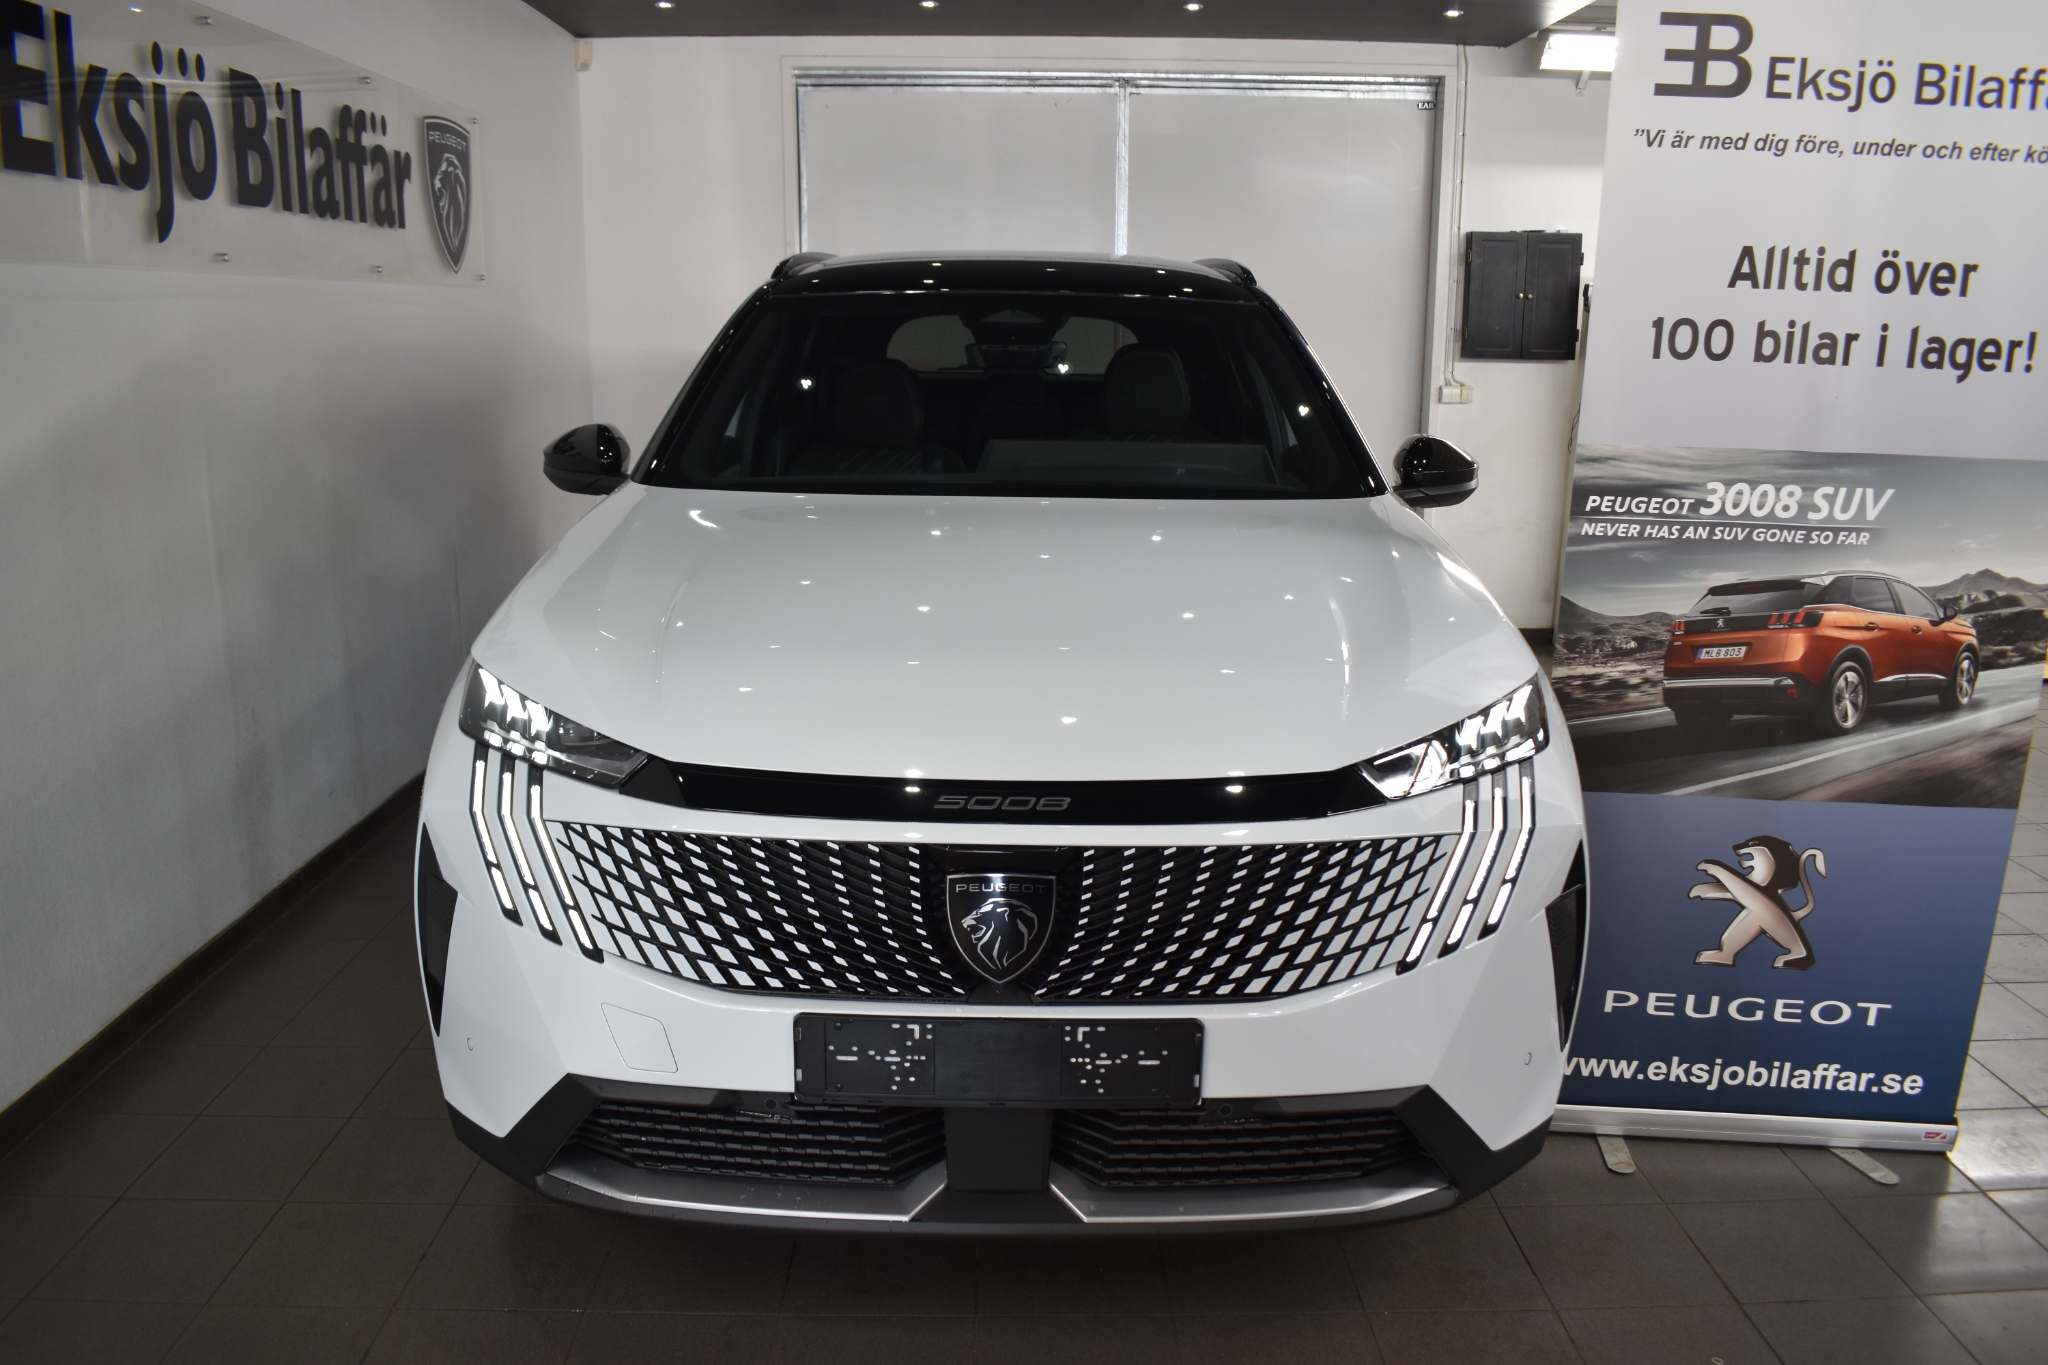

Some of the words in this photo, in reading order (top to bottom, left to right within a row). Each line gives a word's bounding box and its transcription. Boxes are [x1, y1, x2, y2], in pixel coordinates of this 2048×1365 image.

[1765, 56, 1897, 113] Eksjö
[1913, 62, 2048, 111] Bilaff
[0, 0, 218, 243] Eksjö
[229, 67, 412, 229] Bilaffär
[429, 131, 467, 152] PEUGEOT
[1670, 130, 1694, 149] är
[1699, 132, 1750, 151] med
[1754, 133, 1789, 158] dig
[1794, 134, 1845, 158] före,
[1852, 138, 1917, 158] under
[1922, 141, 1964, 160] och
[1969, 142, 2020, 163] efter
[1727, 245, 1857, 293] Alltid
[1874, 249, 1979, 298] över
[1651, 317, 1734, 362] 100
[1753, 319, 1860, 367] bilar
[1876, 323, 1890, 368] i
[1906, 325, 2038, 384] lager!
[1585, 495, 1696, 515] PEUGEOT
[1699, 481, 1803, 519] 3008
[1806, 486, 1896, 521] SUV
[1581, 522, 1640, 537] NEVER
[1643, 525, 1681, 539] HAS
[1682, 526, 1710, 540] AN
[1712, 526, 1750, 541] SUV
[1752, 528, 1806, 544] GONE
[1809, 531, 1833, 545] SO
[1836, 531, 1871, 546] FAR
[1703, 647, 1721, 658] MLB
[1723, 647, 1742, 657] 803
[933, 795, 1072, 811] 5008
[955, 882, 1047, 893] PEUGEOT
[1603, 990, 1893, 1027] PEUGEOT
